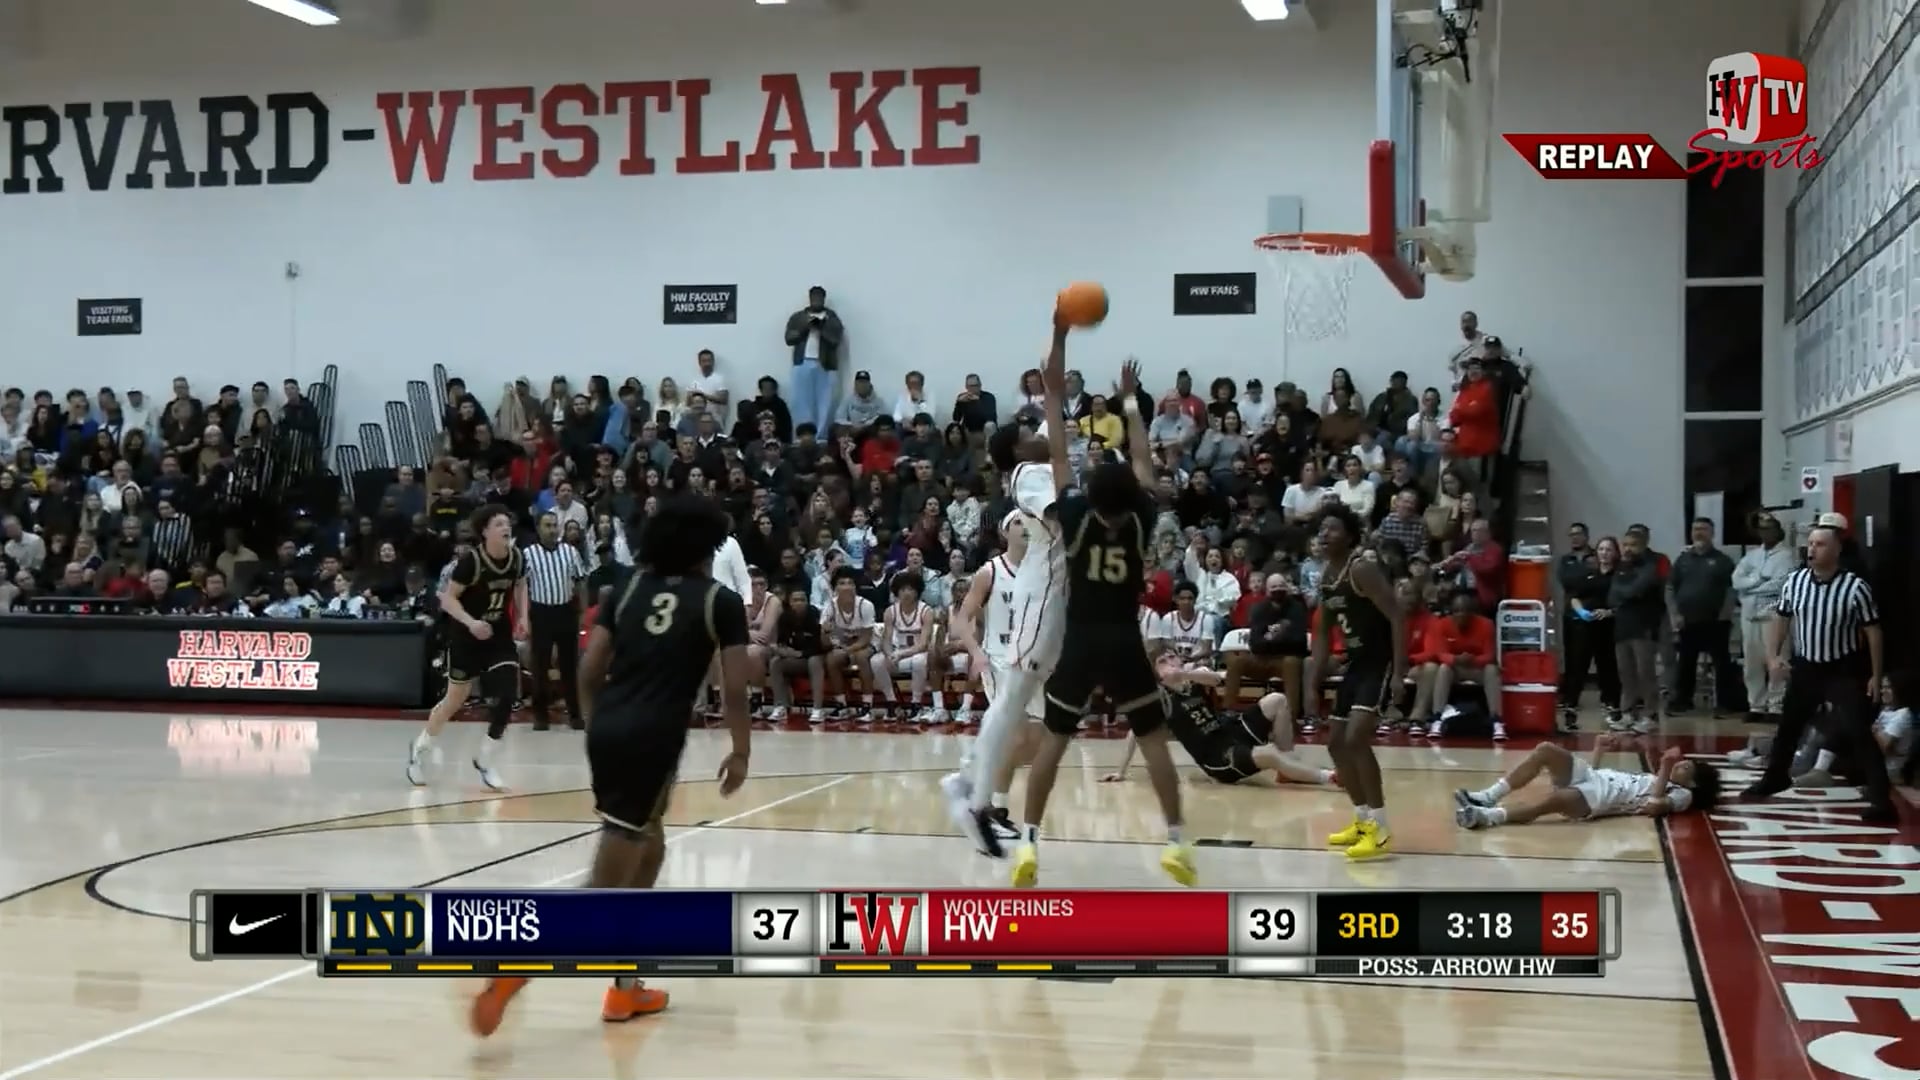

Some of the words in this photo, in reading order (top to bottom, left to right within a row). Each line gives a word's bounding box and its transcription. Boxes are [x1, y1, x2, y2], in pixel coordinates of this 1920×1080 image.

[670, 292, 687, 302] HW
[689, 291, 730, 302] FACULTY
[1211, 285, 1240, 296] FANS
[673, 303, 695, 313] AND
[697, 302, 727, 312] STAFF
[86, 315, 110, 325] TEAM
[111, 314, 134, 324] FANS
[1087, 544, 1128, 585] 15
[644, 592, 679, 635] 3
[1337, 613, 1352, 634] 2
[178, 630, 312, 660] HARVARD
[167, 658, 320, 690] WESTLAKE
